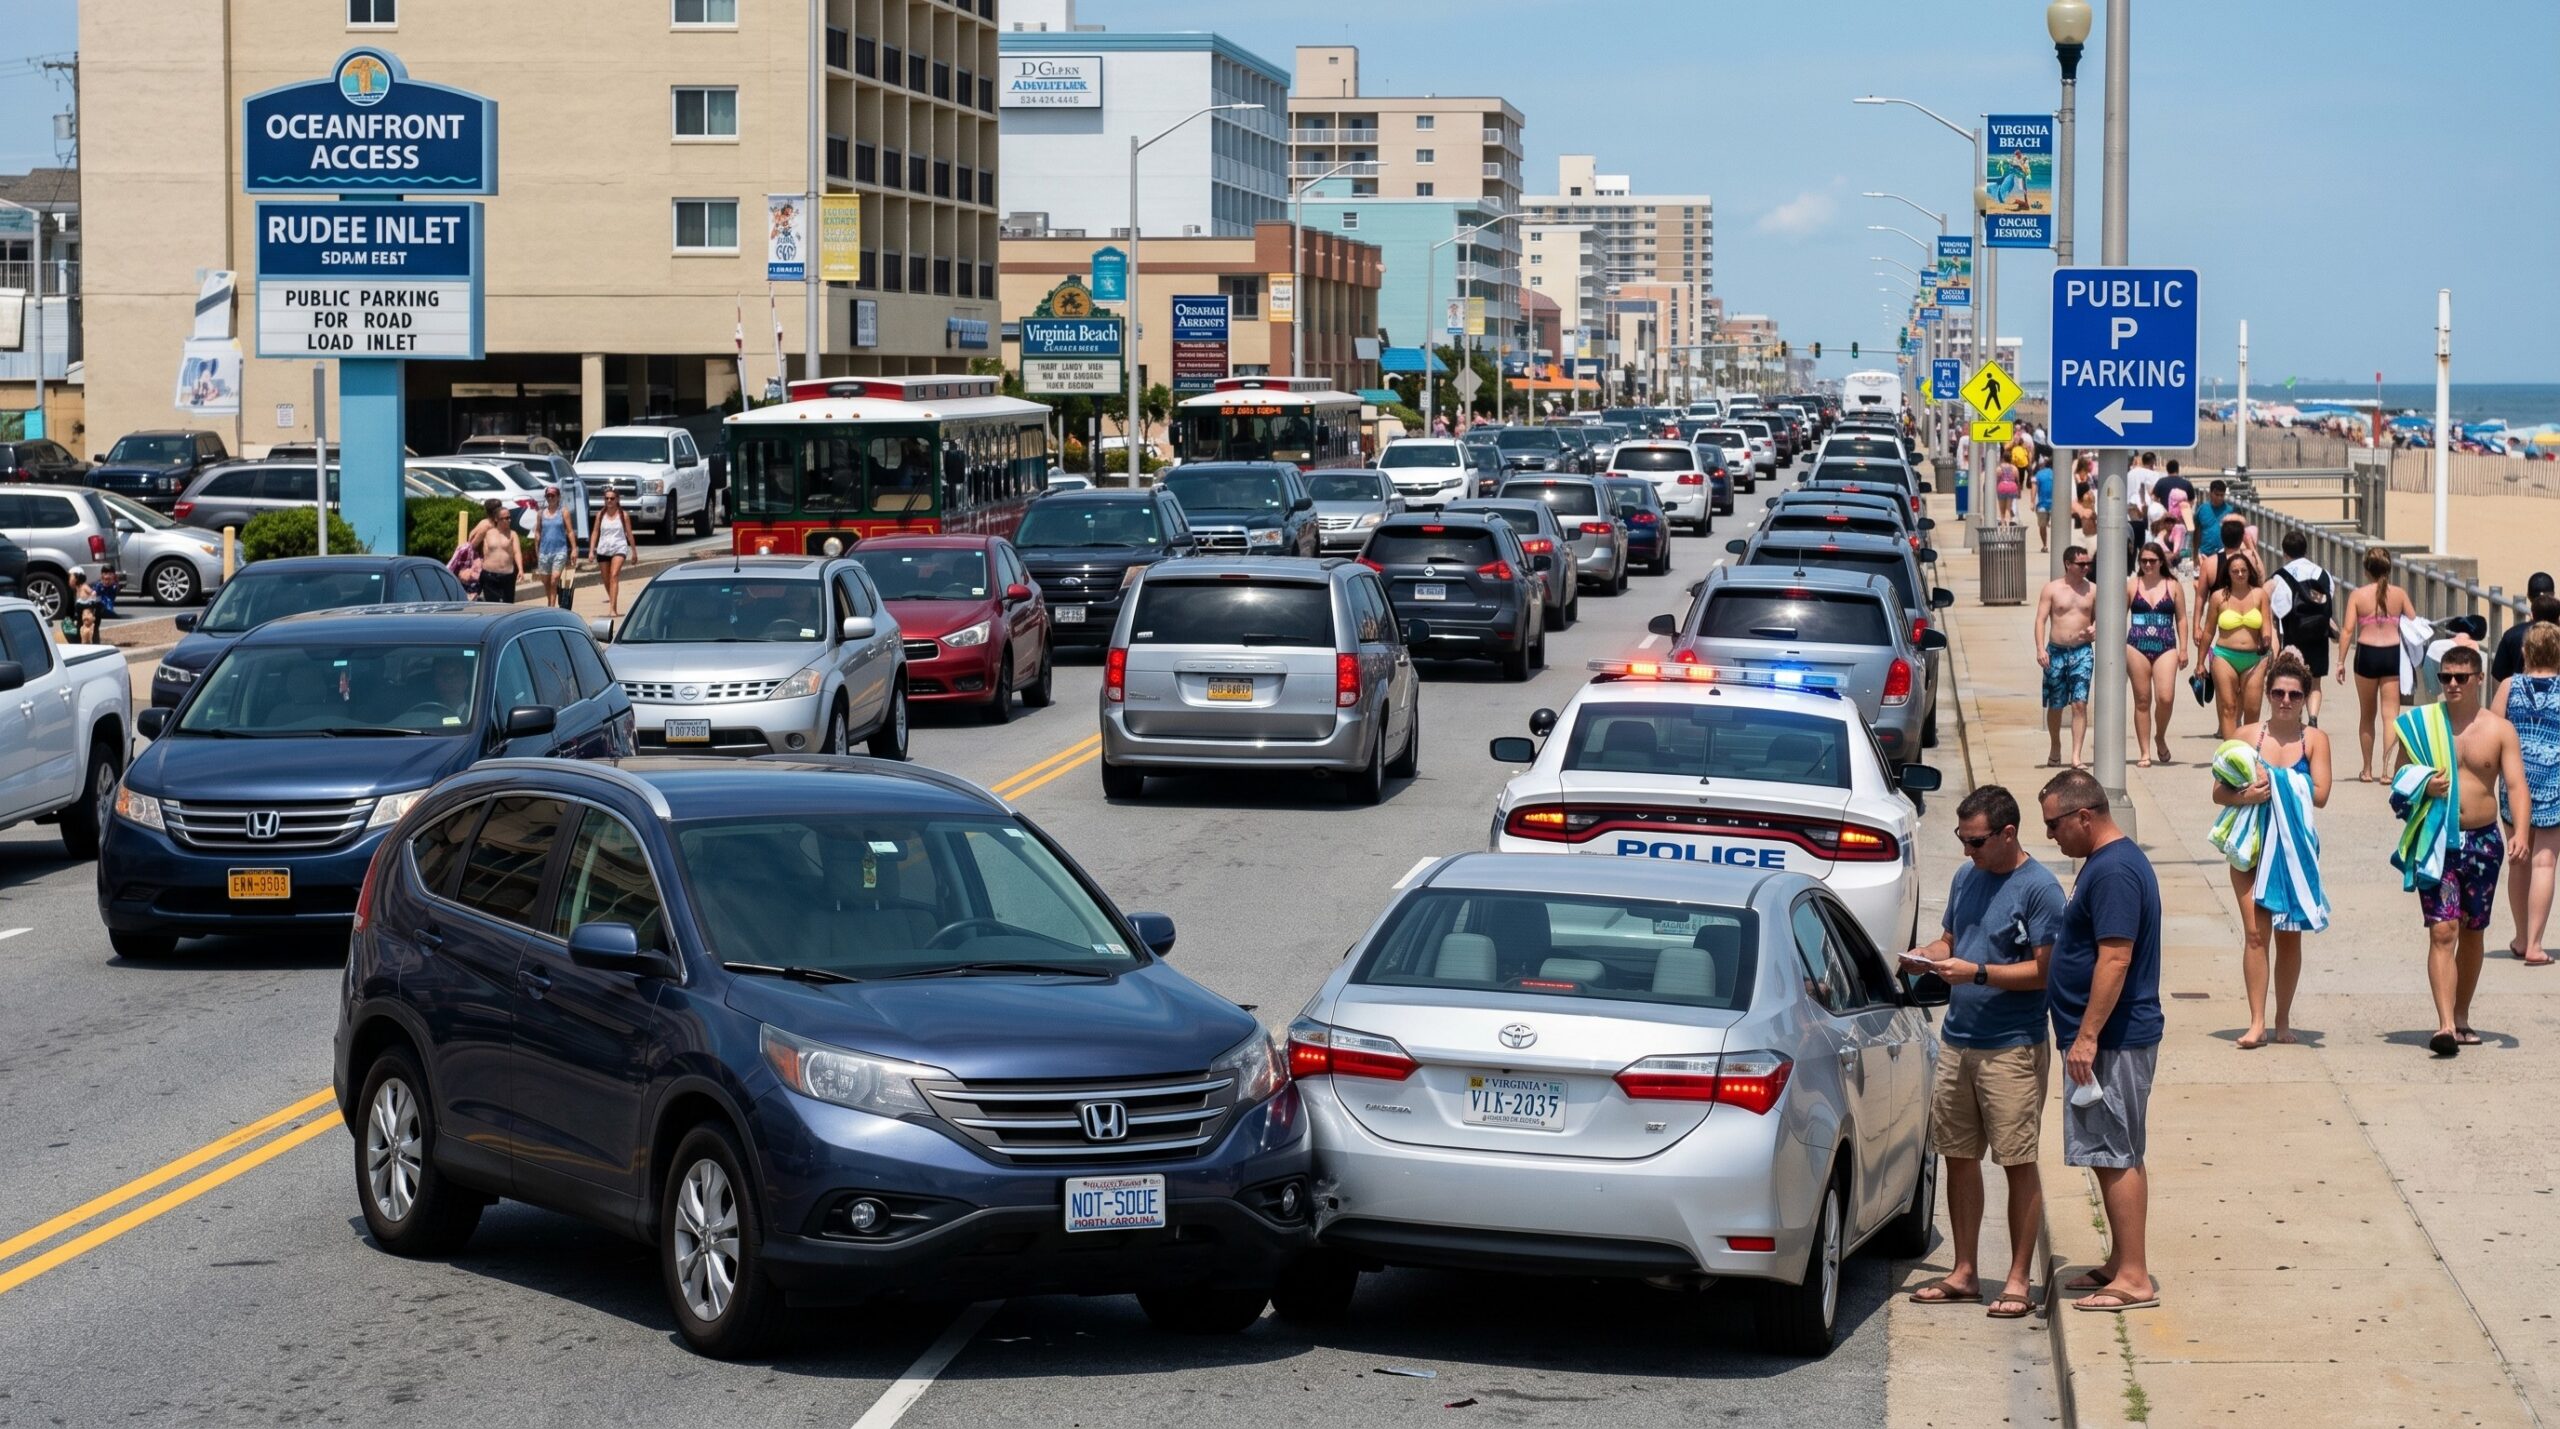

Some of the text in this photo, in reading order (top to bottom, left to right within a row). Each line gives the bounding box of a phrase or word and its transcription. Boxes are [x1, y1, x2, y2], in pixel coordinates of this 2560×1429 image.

[266, 114, 465, 140] OCEANFRONT
[1991, 124, 2049, 135] VIRGINIA
[1999, 137, 2041, 148] BEACH
[310, 144, 420, 170] ACCESS
[268, 216, 461, 244] RUDEE INLET
[285, 290, 440, 308] PUBLIC PARKING
[2067, 280, 2184, 308] PUBLIC
[314, 312, 413, 328] FOR ROAD
[307, 333, 418, 351] LOAD INLET
[1026, 324, 1118, 346] Virginia Beach
[2111, 316, 2139, 350] P
[2061, 359, 2186, 388] PARKING
[1617, 839, 1786, 870] POLICE
[1491, 1078, 1541, 1091] VIRGINIA
[1110, 1215, 1155, 1226] CAROLINA
